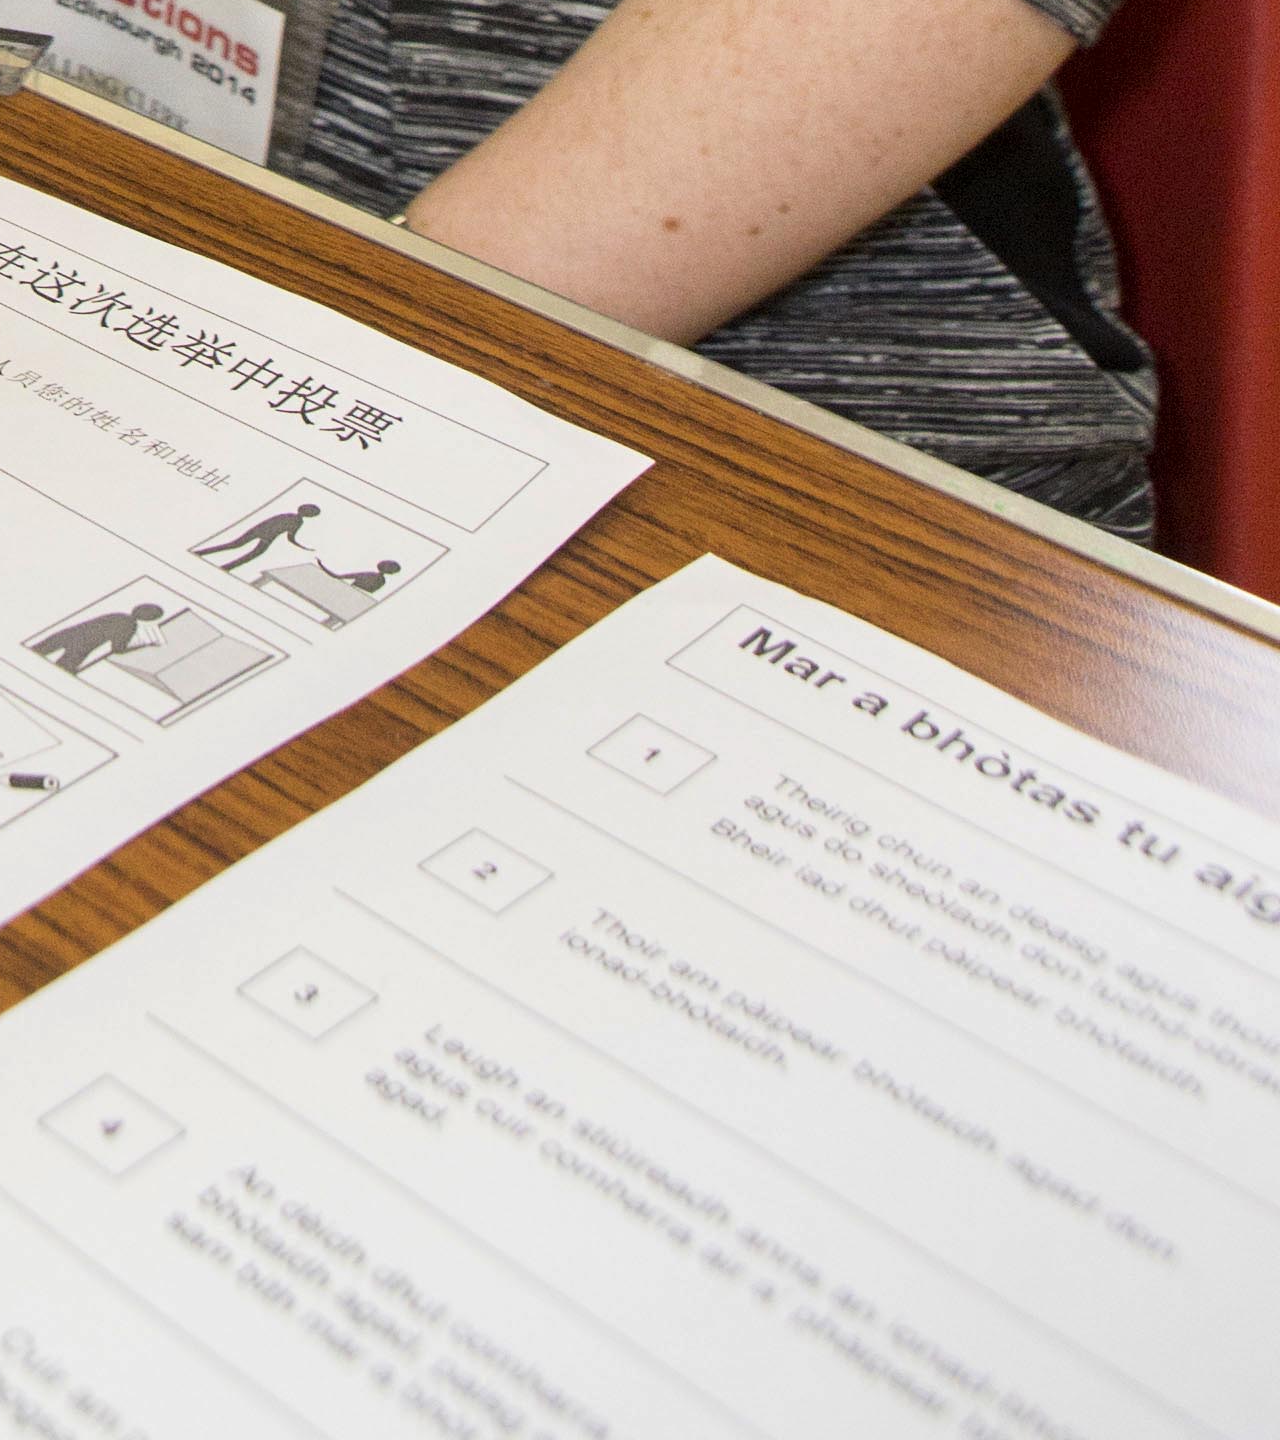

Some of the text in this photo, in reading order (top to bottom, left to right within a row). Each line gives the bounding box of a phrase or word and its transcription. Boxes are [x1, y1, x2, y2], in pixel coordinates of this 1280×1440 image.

[189, 51, 257, 105] 2014
[644, 749, 661, 763] 1
[739, 627, 846, 689] Mar
[852, 693, 889, 717] a
[900, 710, 1099, 825] bhòtas
[1118, 822, 1179, 865] tu
[473, 862, 498, 881] 2
